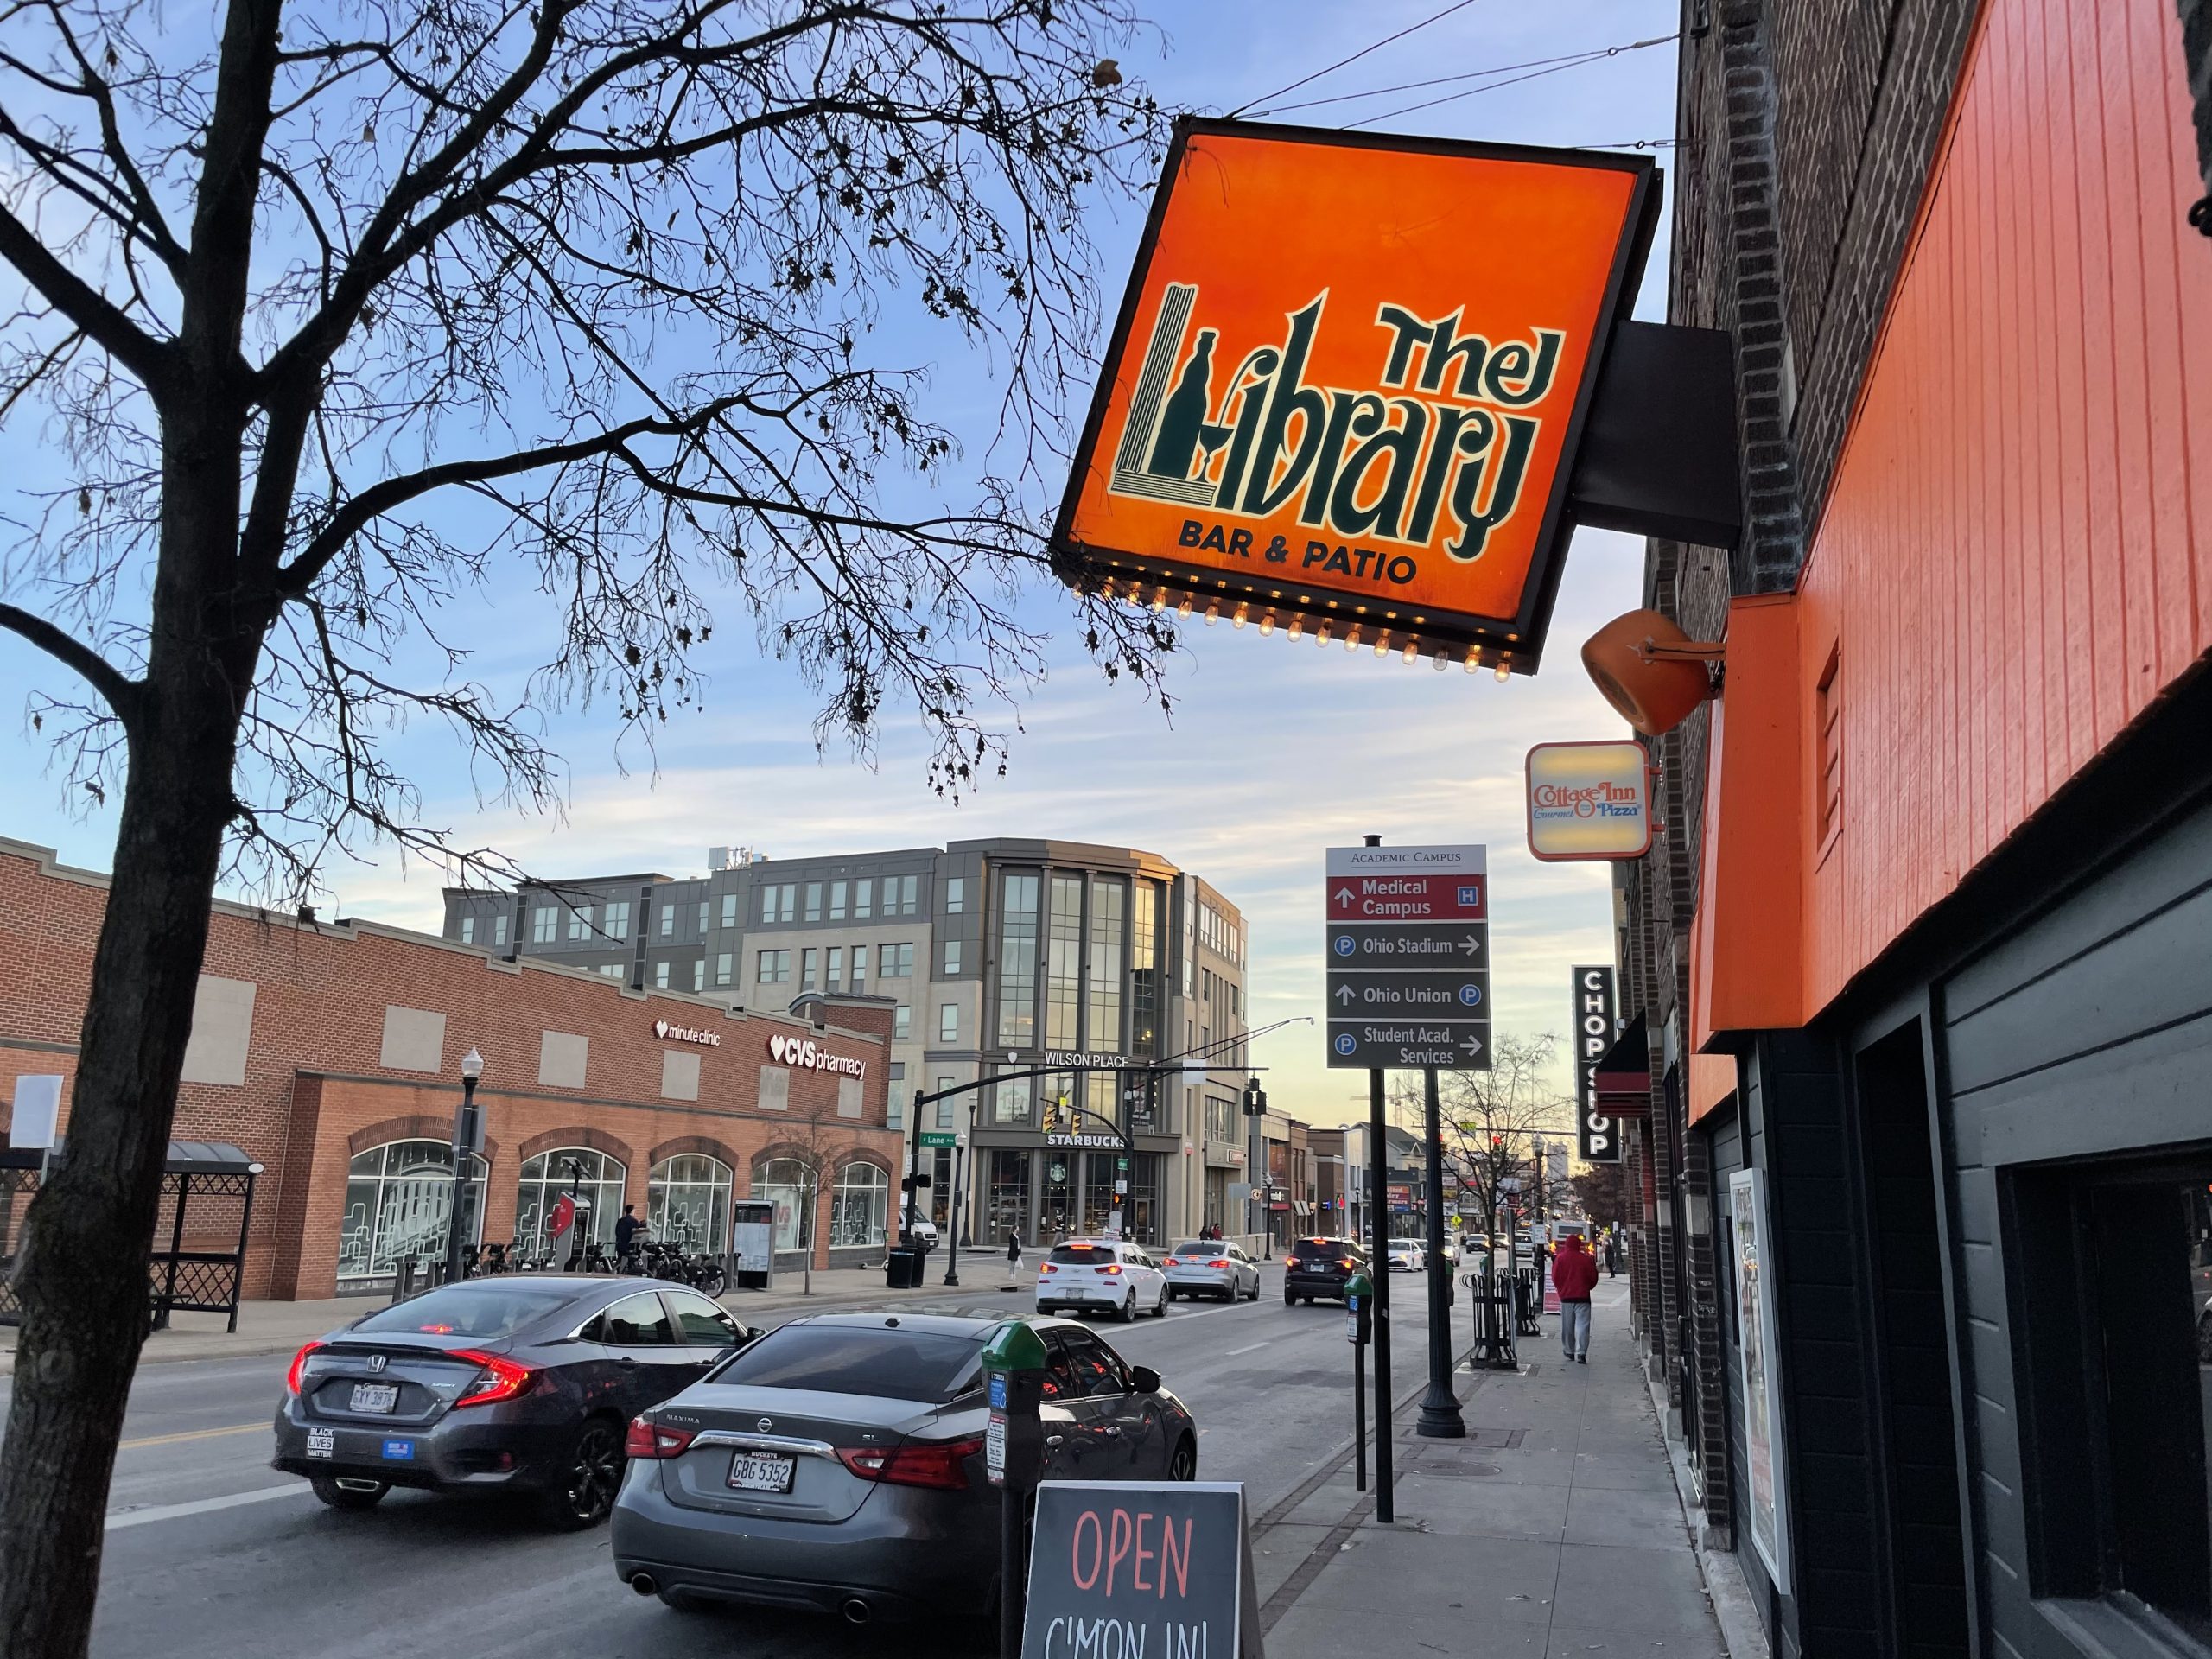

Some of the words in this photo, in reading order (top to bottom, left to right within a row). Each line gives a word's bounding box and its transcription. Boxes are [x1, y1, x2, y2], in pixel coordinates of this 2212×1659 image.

[1375, 302, 1567, 410] The
[1109, 282, 1542, 563] Library
[1179, 519, 1253, 558] BAR
[1265, 535, 1288, 563] &
[1302, 541, 1417, 585] PATIO
[1533, 785, 1601, 818] Cottage
[1598, 782, 1637, 802] Inn
[1596, 803, 1637, 817] Pizza
[1362, 879, 1427, 895] Medical
[1462, 890, 1473, 902] H
[1363, 899, 1431, 918] Campus
[1340, 940, 1351, 952] P
[1363, 938, 1394, 954] Ohio
[1397, 938, 1452, 954] Stadium
[1363, 987, 1401, 1003] Ohio
[1405, 987, 1452, 1003] Union
[1465, 988, 1477, 1002] P
[1584, 970, 1606, 1058] CHOP
[1364, 1027, 1414, 1043] Student
[1417, 1027, 1454, 1044] Acad.
[1341, 1038, 1351, 1052] P
[785, 1037, 817, 1068] CVS
[816, 1048, 866, 1080] pharmacy
[1045, 1052, 1090, 1067] WILSON
[1400, 1047, 1454, 1065] Services
[927, 1135, 945, 1144] Lane
[666, 1414, 701, 1425] MAXIMA
[309, 1427, 334, 1437] BLACK
[308, 1438, 332, 1448] LIVES
[734, 1459, 757, 1480] GBG
[759, 1462, 789, 1484] 5352
[1072, 1508, 1192, 1599] OPEN
[1045, 1616, 1146, 1659] C'MON
